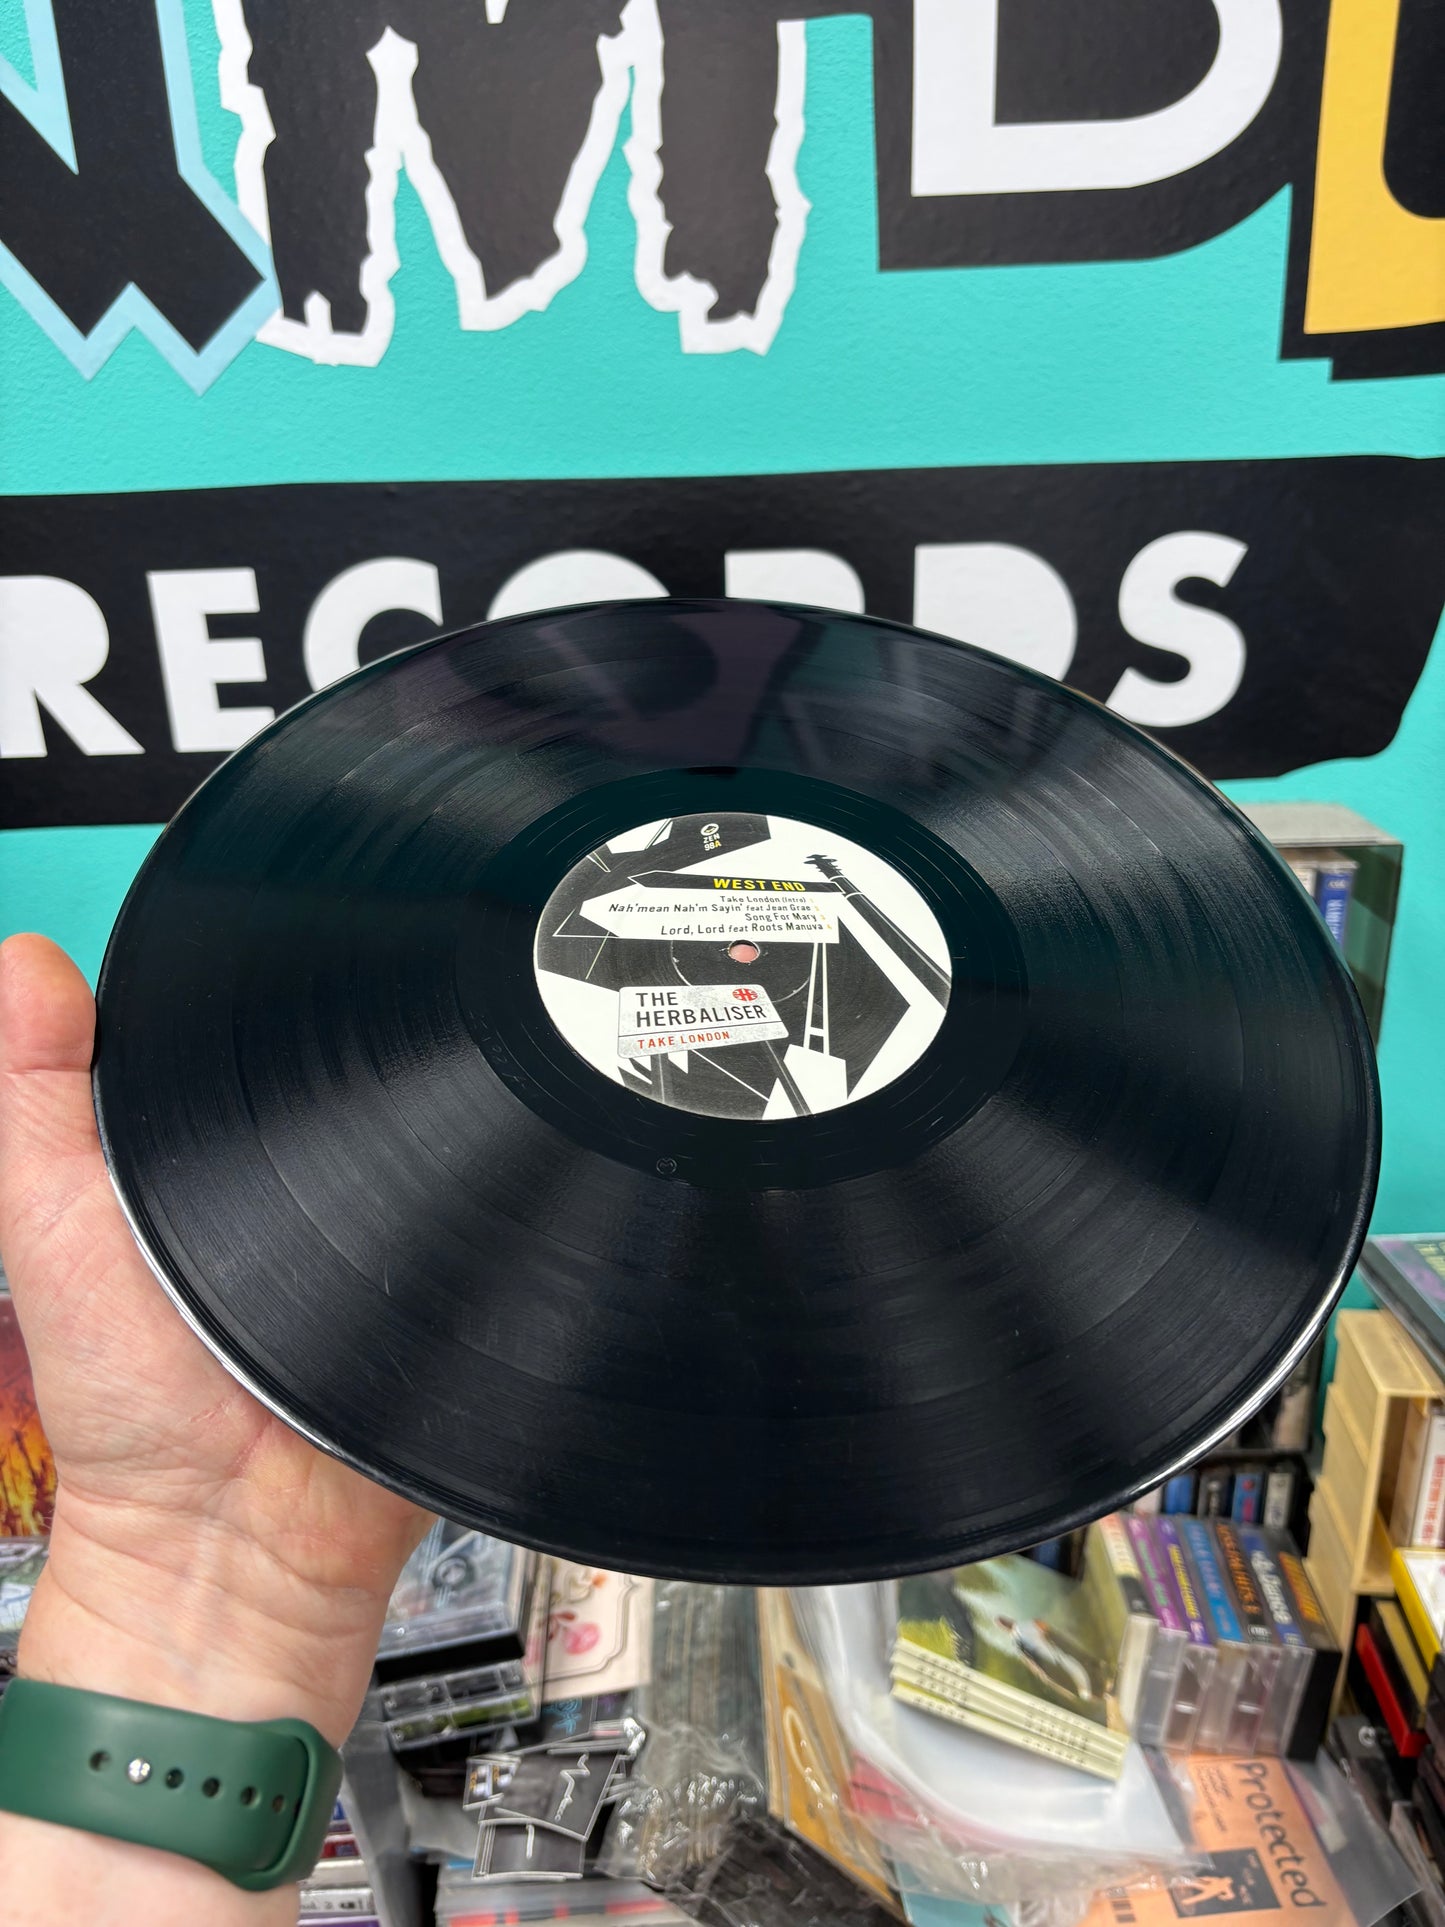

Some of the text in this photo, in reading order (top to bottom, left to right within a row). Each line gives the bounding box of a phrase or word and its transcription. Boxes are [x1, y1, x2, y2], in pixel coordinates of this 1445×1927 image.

[703, 833, 720, 844] ZEN
[704, 840, 722, 851] 98A
[713, 878, 806, 892] WEST END
[720, 895, 745, 903] Take
[608, 903, 670, 913] Nah'mean
[673, 903, 708, 913] Nah'm
[711, 903, 743, 914] Sayin'
[766, 904, 788, 912] Jean
[790, 904, 811, 912] Grae
[745, 913, 772, 923] Song
[774, 913, 790, 921] For
[793, 913, 817, 923] Mary
[661, 925, 694, 936] Lord,
[698, 924, 725, 934] Lord
[728, 924, 748, 933] feat
[752, 923, 783, 932] Roots
[785, 922, 823, 931] Manuva
[636, 992, 678, 1007] THE
[636, 1005, 767, 1028] HERBALISER
[638, 1031, 730, 1049] TAKE LONDON
